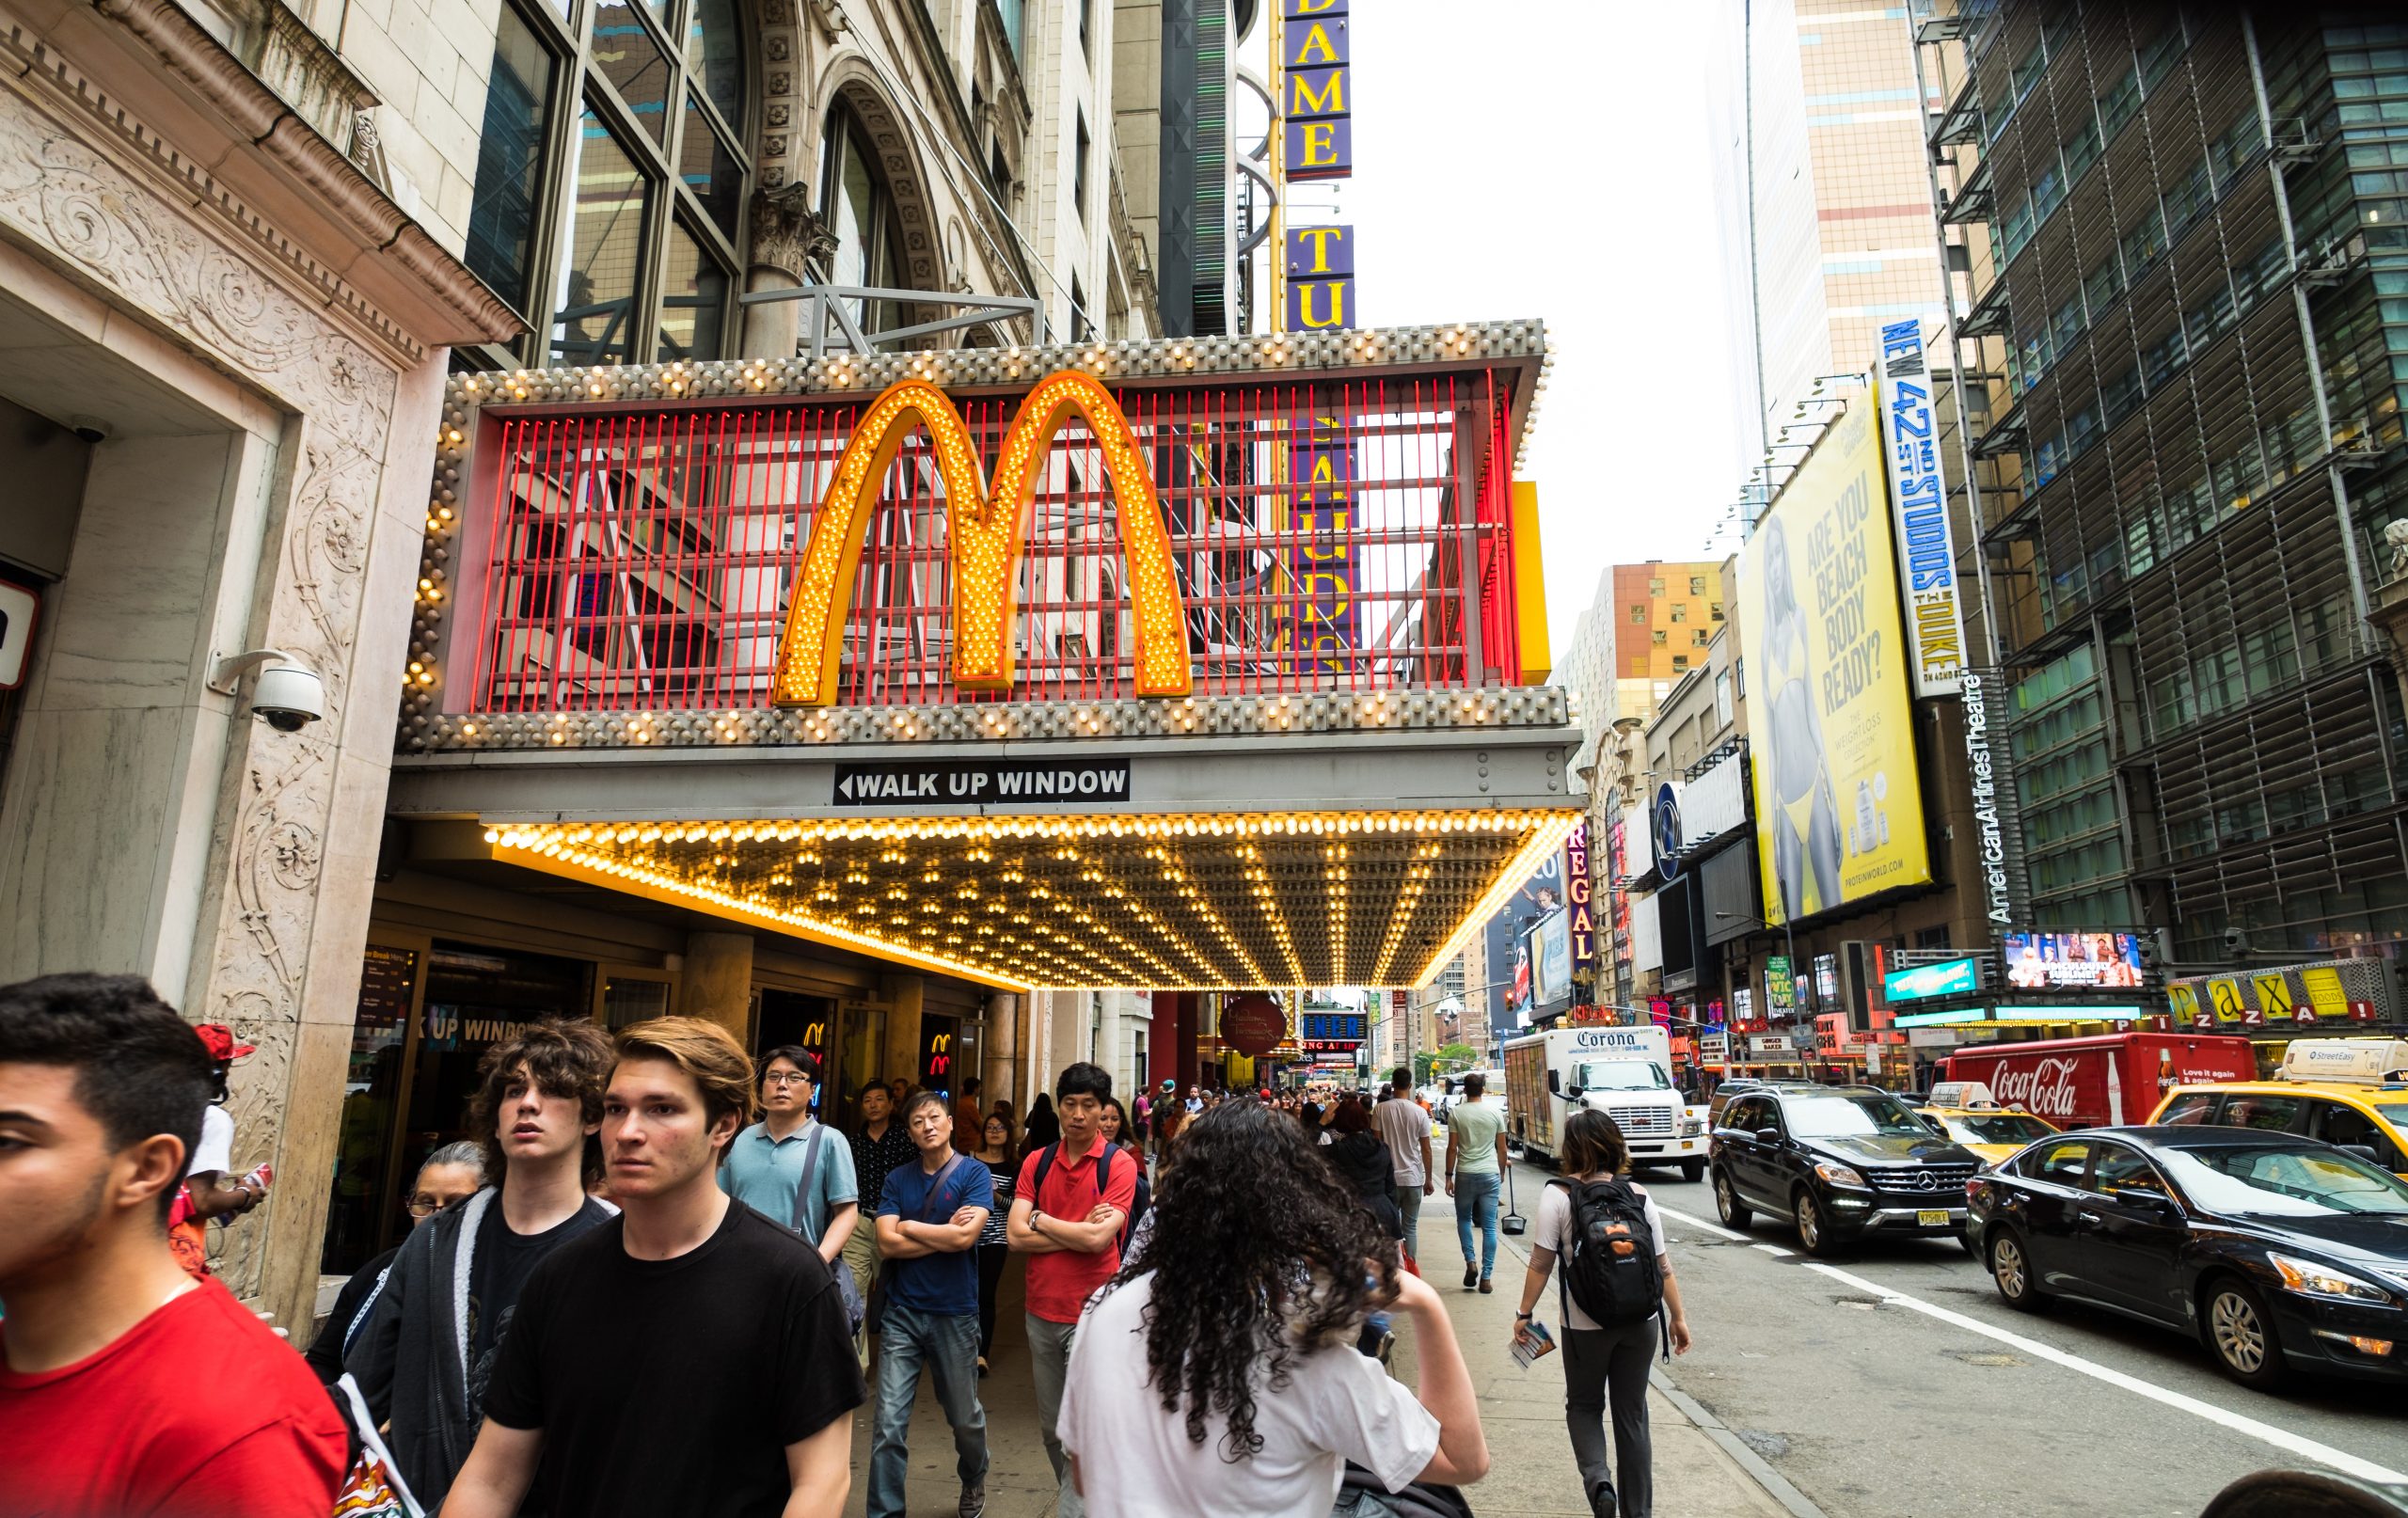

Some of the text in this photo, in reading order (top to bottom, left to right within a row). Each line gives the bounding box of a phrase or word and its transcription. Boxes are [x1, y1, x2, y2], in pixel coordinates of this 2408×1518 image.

[1882, 319, 1924, 377] NEW
[1807, 509, 1834, 578] ARE
[1835, 468, 1869, 543] YOU
[1900, 475, 1952, 592] STUDIOS
[1815, 529, 1868, 618] BEACH
[1825, 583, 1866, 662] BODY
[1915, 600, 1962, 672] DUKE
[1822, 629, 1881, 718] READY?
[856, 769, 1126, 798] WALK UP WINDOW
[1568, 825, 1593, 959] REGAL
[1845, 859, 1904, 889] PROTEINWORLD.COM
[2313, 992, 2343, 1003] FOODS
[433, 1019, 458, 1040] UP
[1577, 1031, 1636, 1047] Corona
[2317, 1051, 2356, 1063] StreetEasy
[1990, 1057, 2080, 1115] Coca-Cola
[2183, 1068, 2203, 1077] Love
[2212, 1070, 2235, 1079] again
